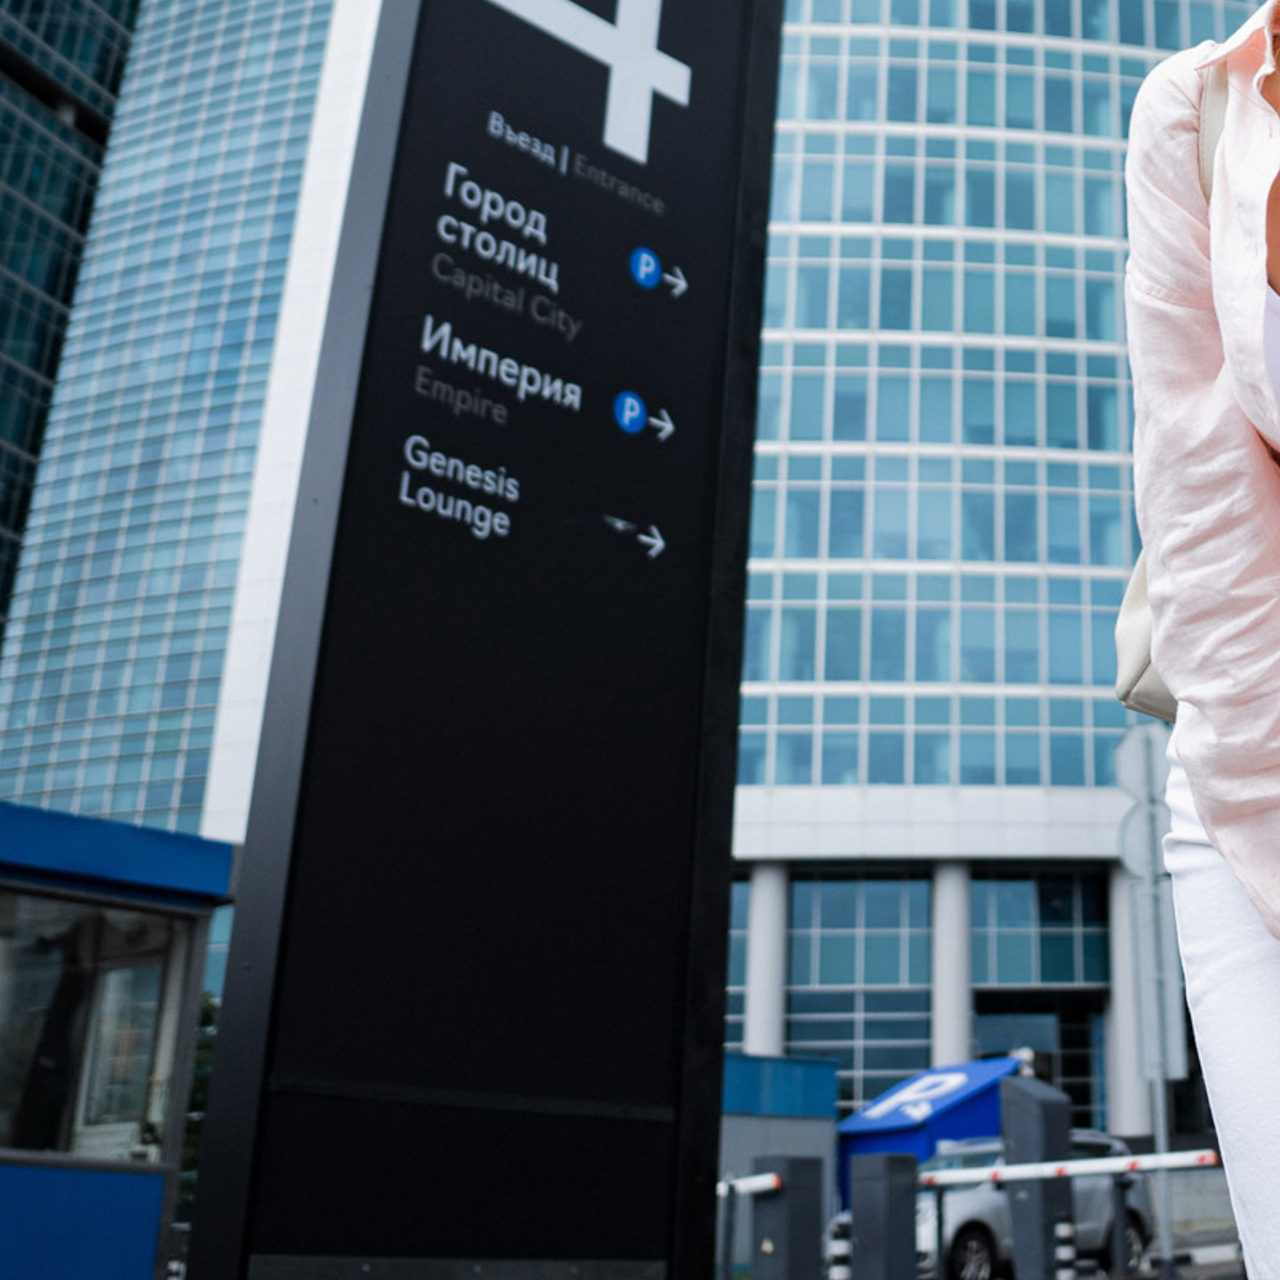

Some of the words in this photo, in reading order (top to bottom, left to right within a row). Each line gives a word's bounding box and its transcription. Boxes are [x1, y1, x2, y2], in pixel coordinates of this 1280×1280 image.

[487, 110, 556, 167] Въезд
[574, 154, 664, 213] Entrance
[445, 162, 547, 244] Город
[437, 214, 560, 293] столиц
[431, 252, 523, 311] Capital
[530, 293, 583, 341] City
[414, 365, 508, 426] Empire
[421, 314, 582, 411] Империя
[400, 471, 511, 539] Lounge
[404, 434, 520, 502] Genesis
